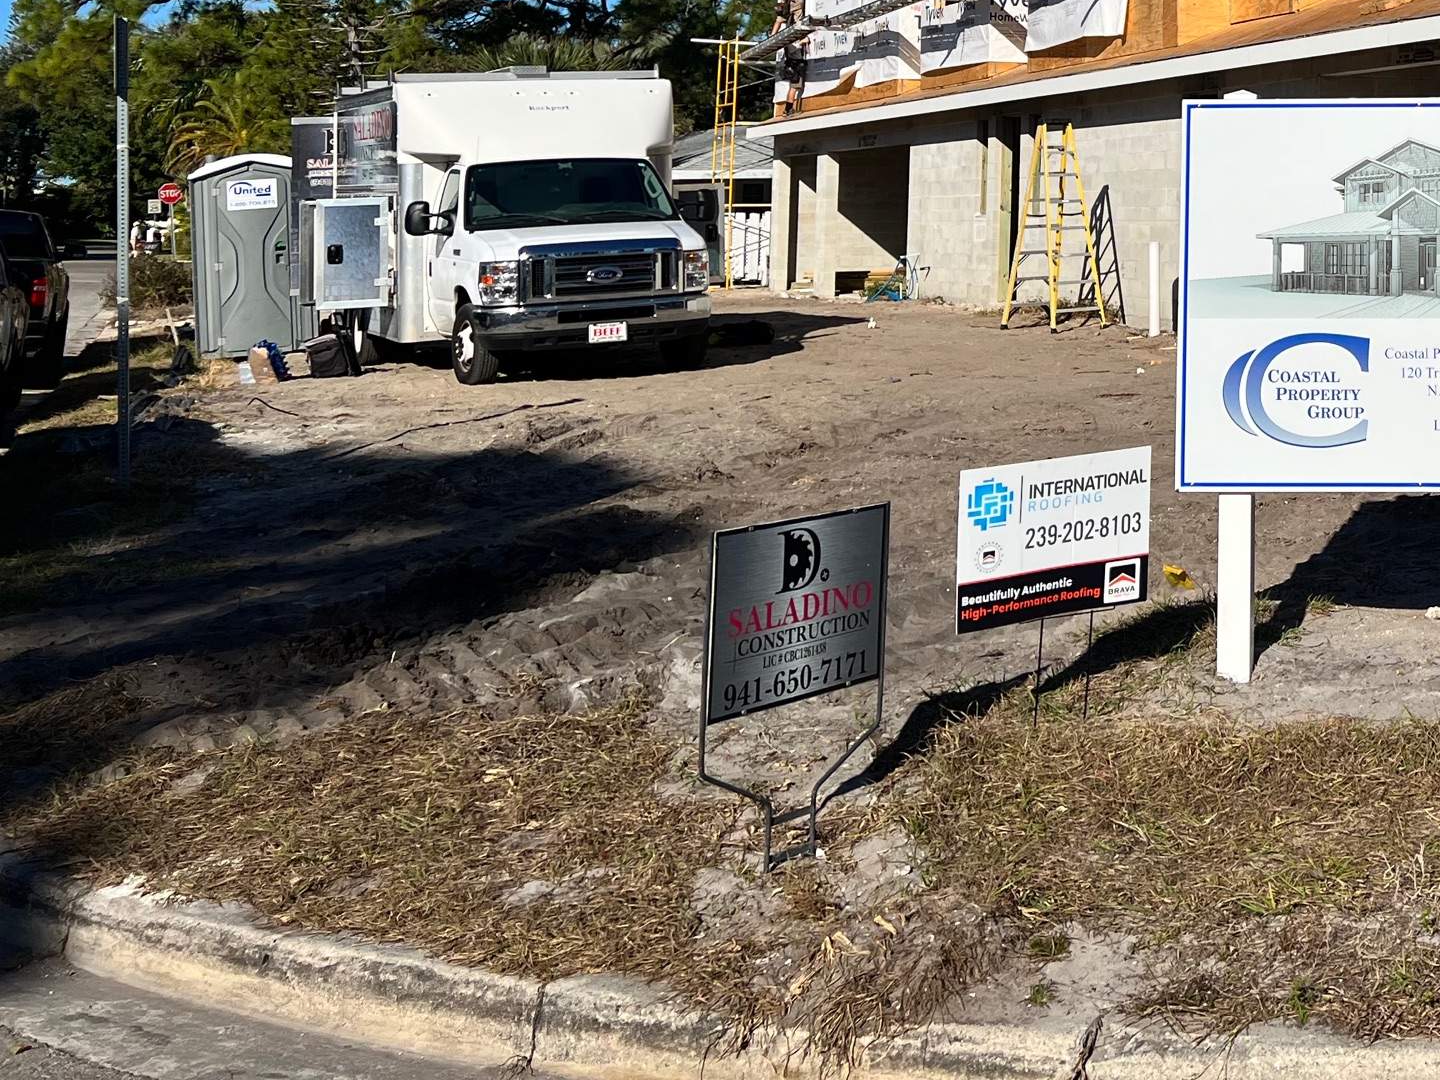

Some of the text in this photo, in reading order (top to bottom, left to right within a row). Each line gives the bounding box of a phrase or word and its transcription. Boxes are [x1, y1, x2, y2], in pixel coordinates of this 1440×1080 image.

[926, 5, 945, 27] Tyvek
[989, 11, 1028, 23] HomeW
[159, 190, 181, 199] STOP
[233, 184, 271, 195] United
[593, 327, 621, 337] BEEF
[1384, 347, 1429, 360] Coastal
[1267, 369, 1341, 384] COASTAL
[1401, 367, 1422, 379] 120
[1275, 387, 1361, 401] PROPERTY
[1428, 385, 1440, 397] N.
[1307, 405, 1365, 419] GROUP
[1028, 469, 1147, 500] INTERNATIONAL
[1028, 491, 1104, 512] ROOFING
[1025, 511, 1142, 550] 239-202-8103
[961, 576, 1073, 607] Beautifully Authentic
[1108, 585, 1135, 595] BRAVA
[728, 578, 874, 638] SALADINO
[961, 587, 1101, 621] High-Performance Roofing
[737, 610, 870, 657] CONSTRUCTION
[763, 654, 777, 669] LIC
[724, 649, 867, 712] 941-650-7171
